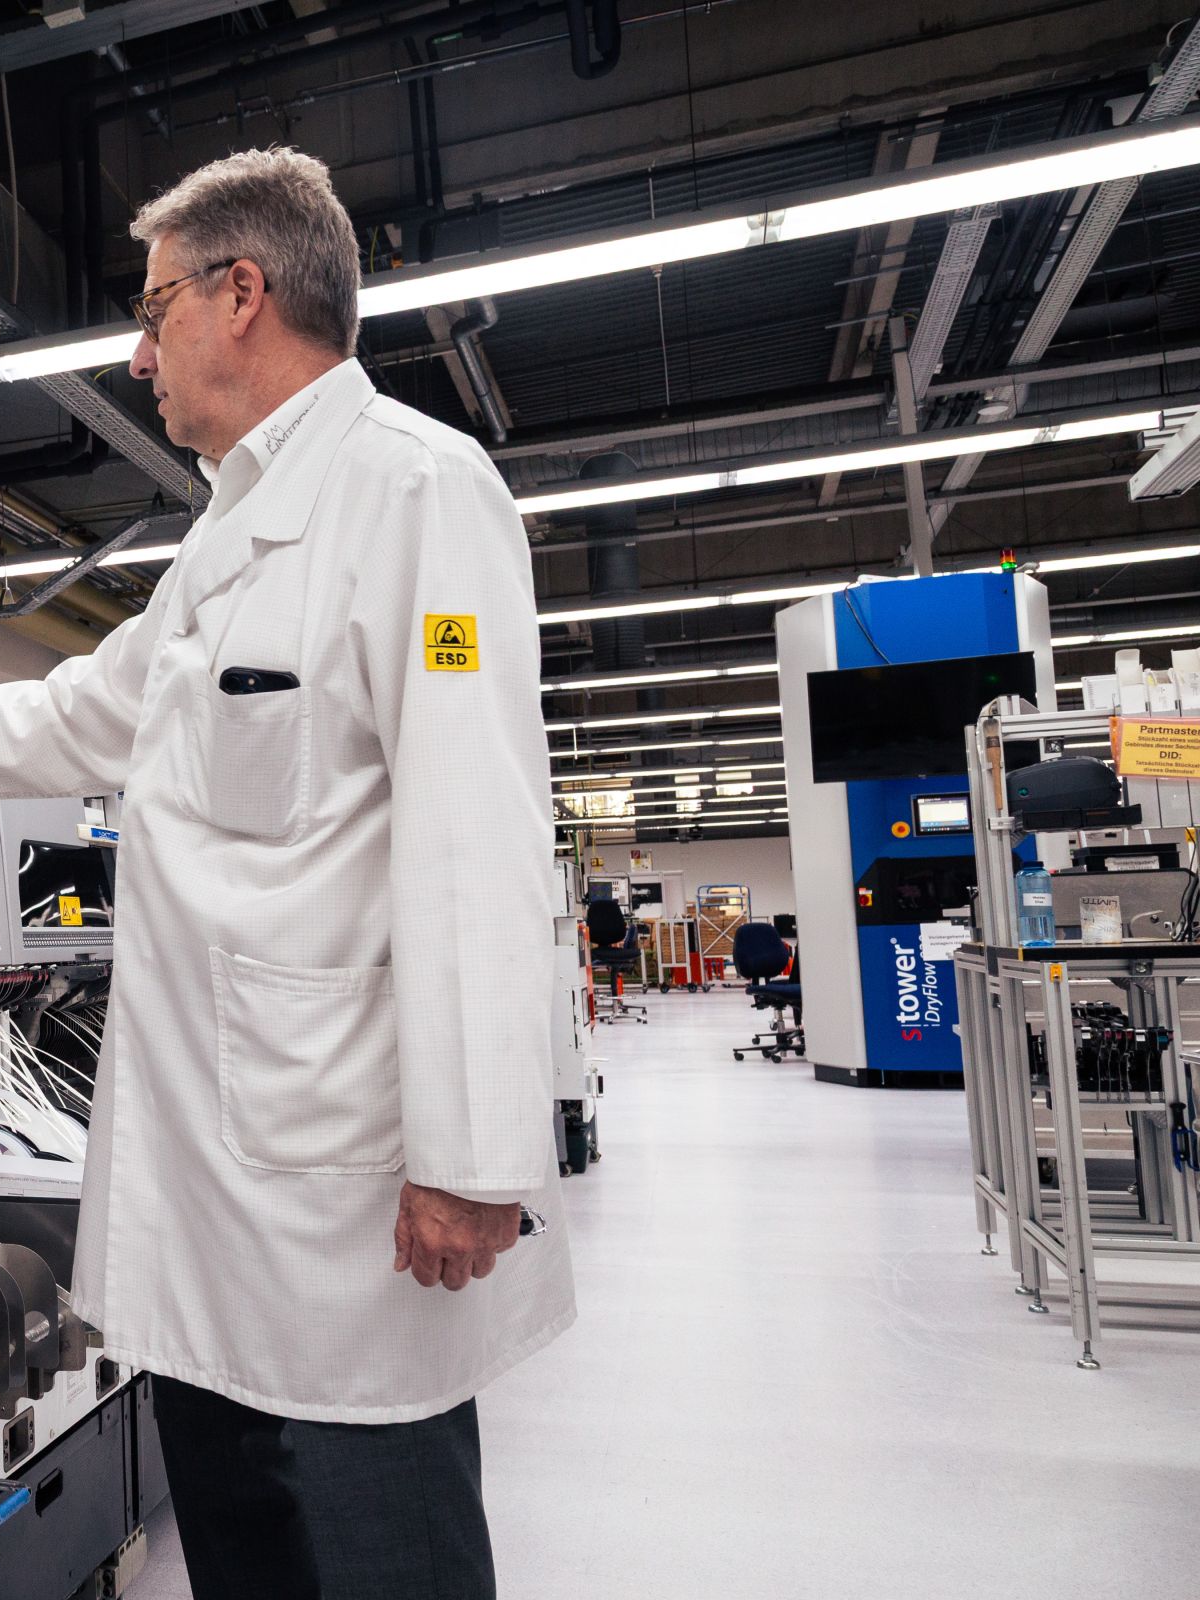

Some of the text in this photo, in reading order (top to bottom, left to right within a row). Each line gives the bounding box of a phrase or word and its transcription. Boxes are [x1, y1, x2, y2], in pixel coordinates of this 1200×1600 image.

[436, 652, 467, 665] ESD
[1159, 751, 1182, 760] DID:
[921, 962, 943, 1023] DryFlow
